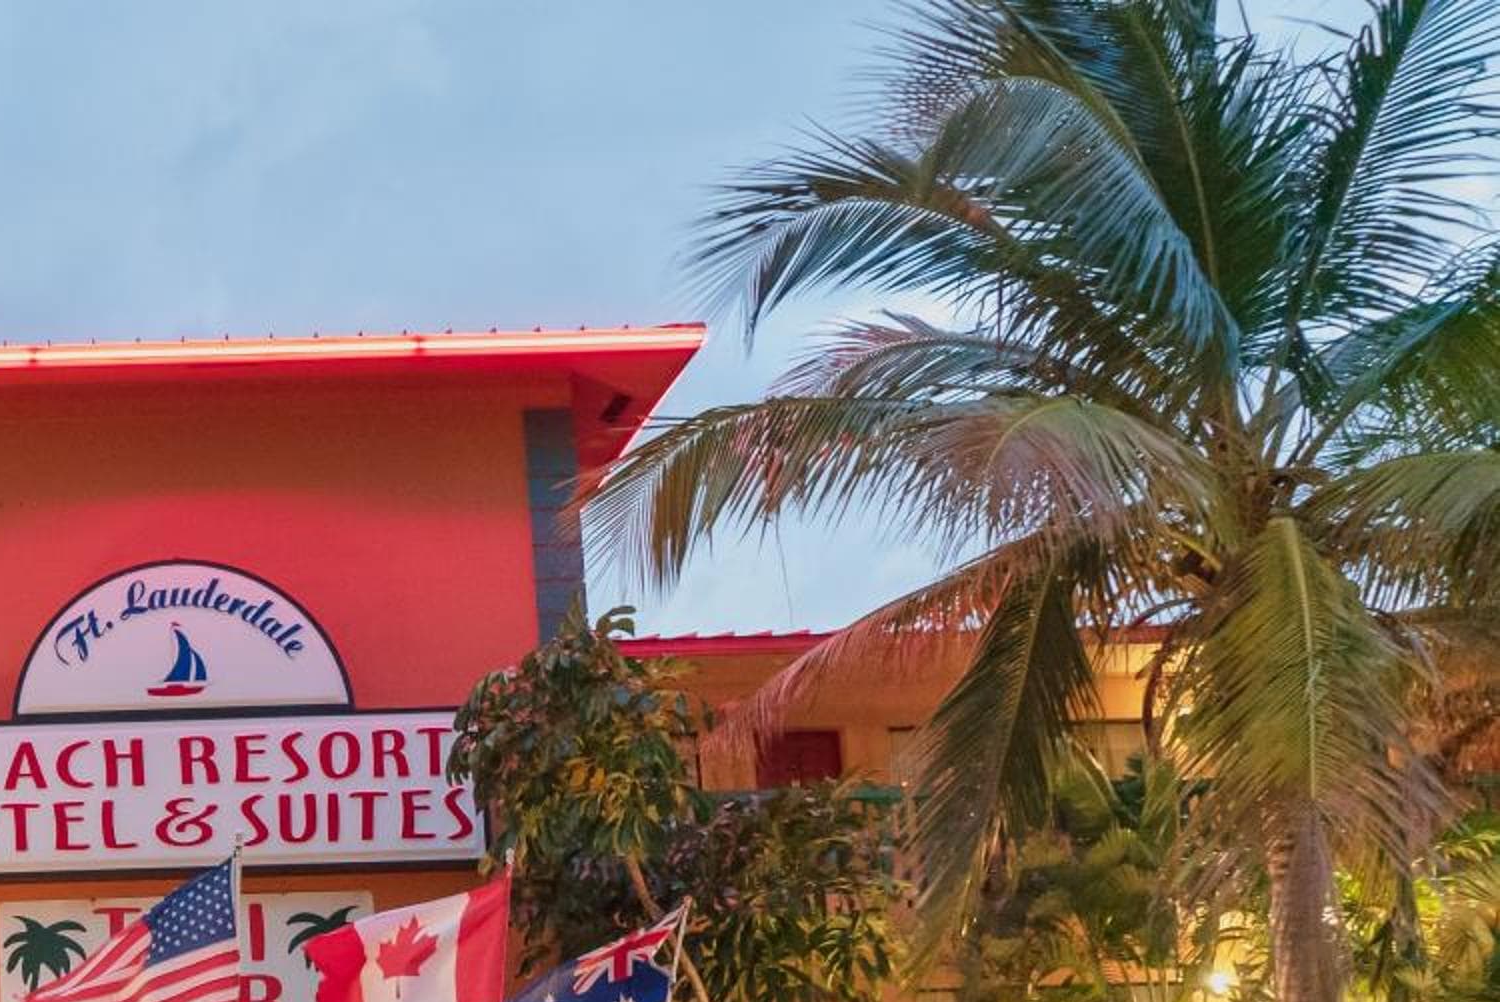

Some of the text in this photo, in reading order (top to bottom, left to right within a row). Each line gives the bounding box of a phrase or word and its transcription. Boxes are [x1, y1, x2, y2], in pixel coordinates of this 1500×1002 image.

[53, 576, 308, 667] Ft. Lauderdale
[179, 727, 455, 785] RESORT
[155, 796, 219, 847] &
[239, 785, 475, 848] SUITES
[92, 902, 266, 962] TI
